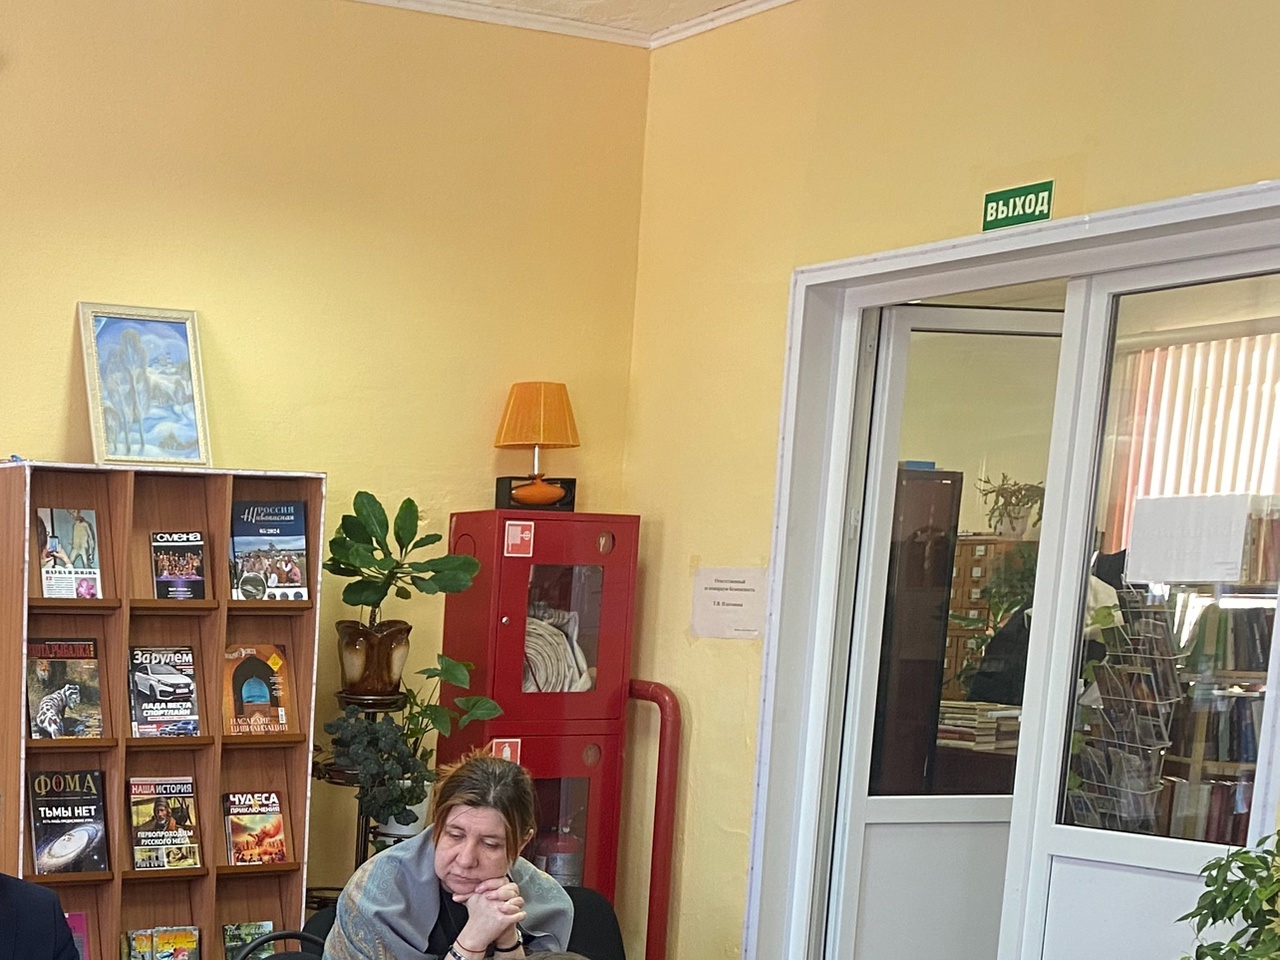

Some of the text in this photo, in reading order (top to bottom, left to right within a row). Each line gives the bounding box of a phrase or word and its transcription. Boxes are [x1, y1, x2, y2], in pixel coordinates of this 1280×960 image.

[986, 190, 1049, 222] ВЫХОД
[34, 773, 98, 796] ФОМА
[131, 784, 192, 794] НАША ИСТОРИЯ
[229, 793, 279, 805] ЧУДЕСА
[38, 805, 97, 818] ТЬМЫ НЕТ
